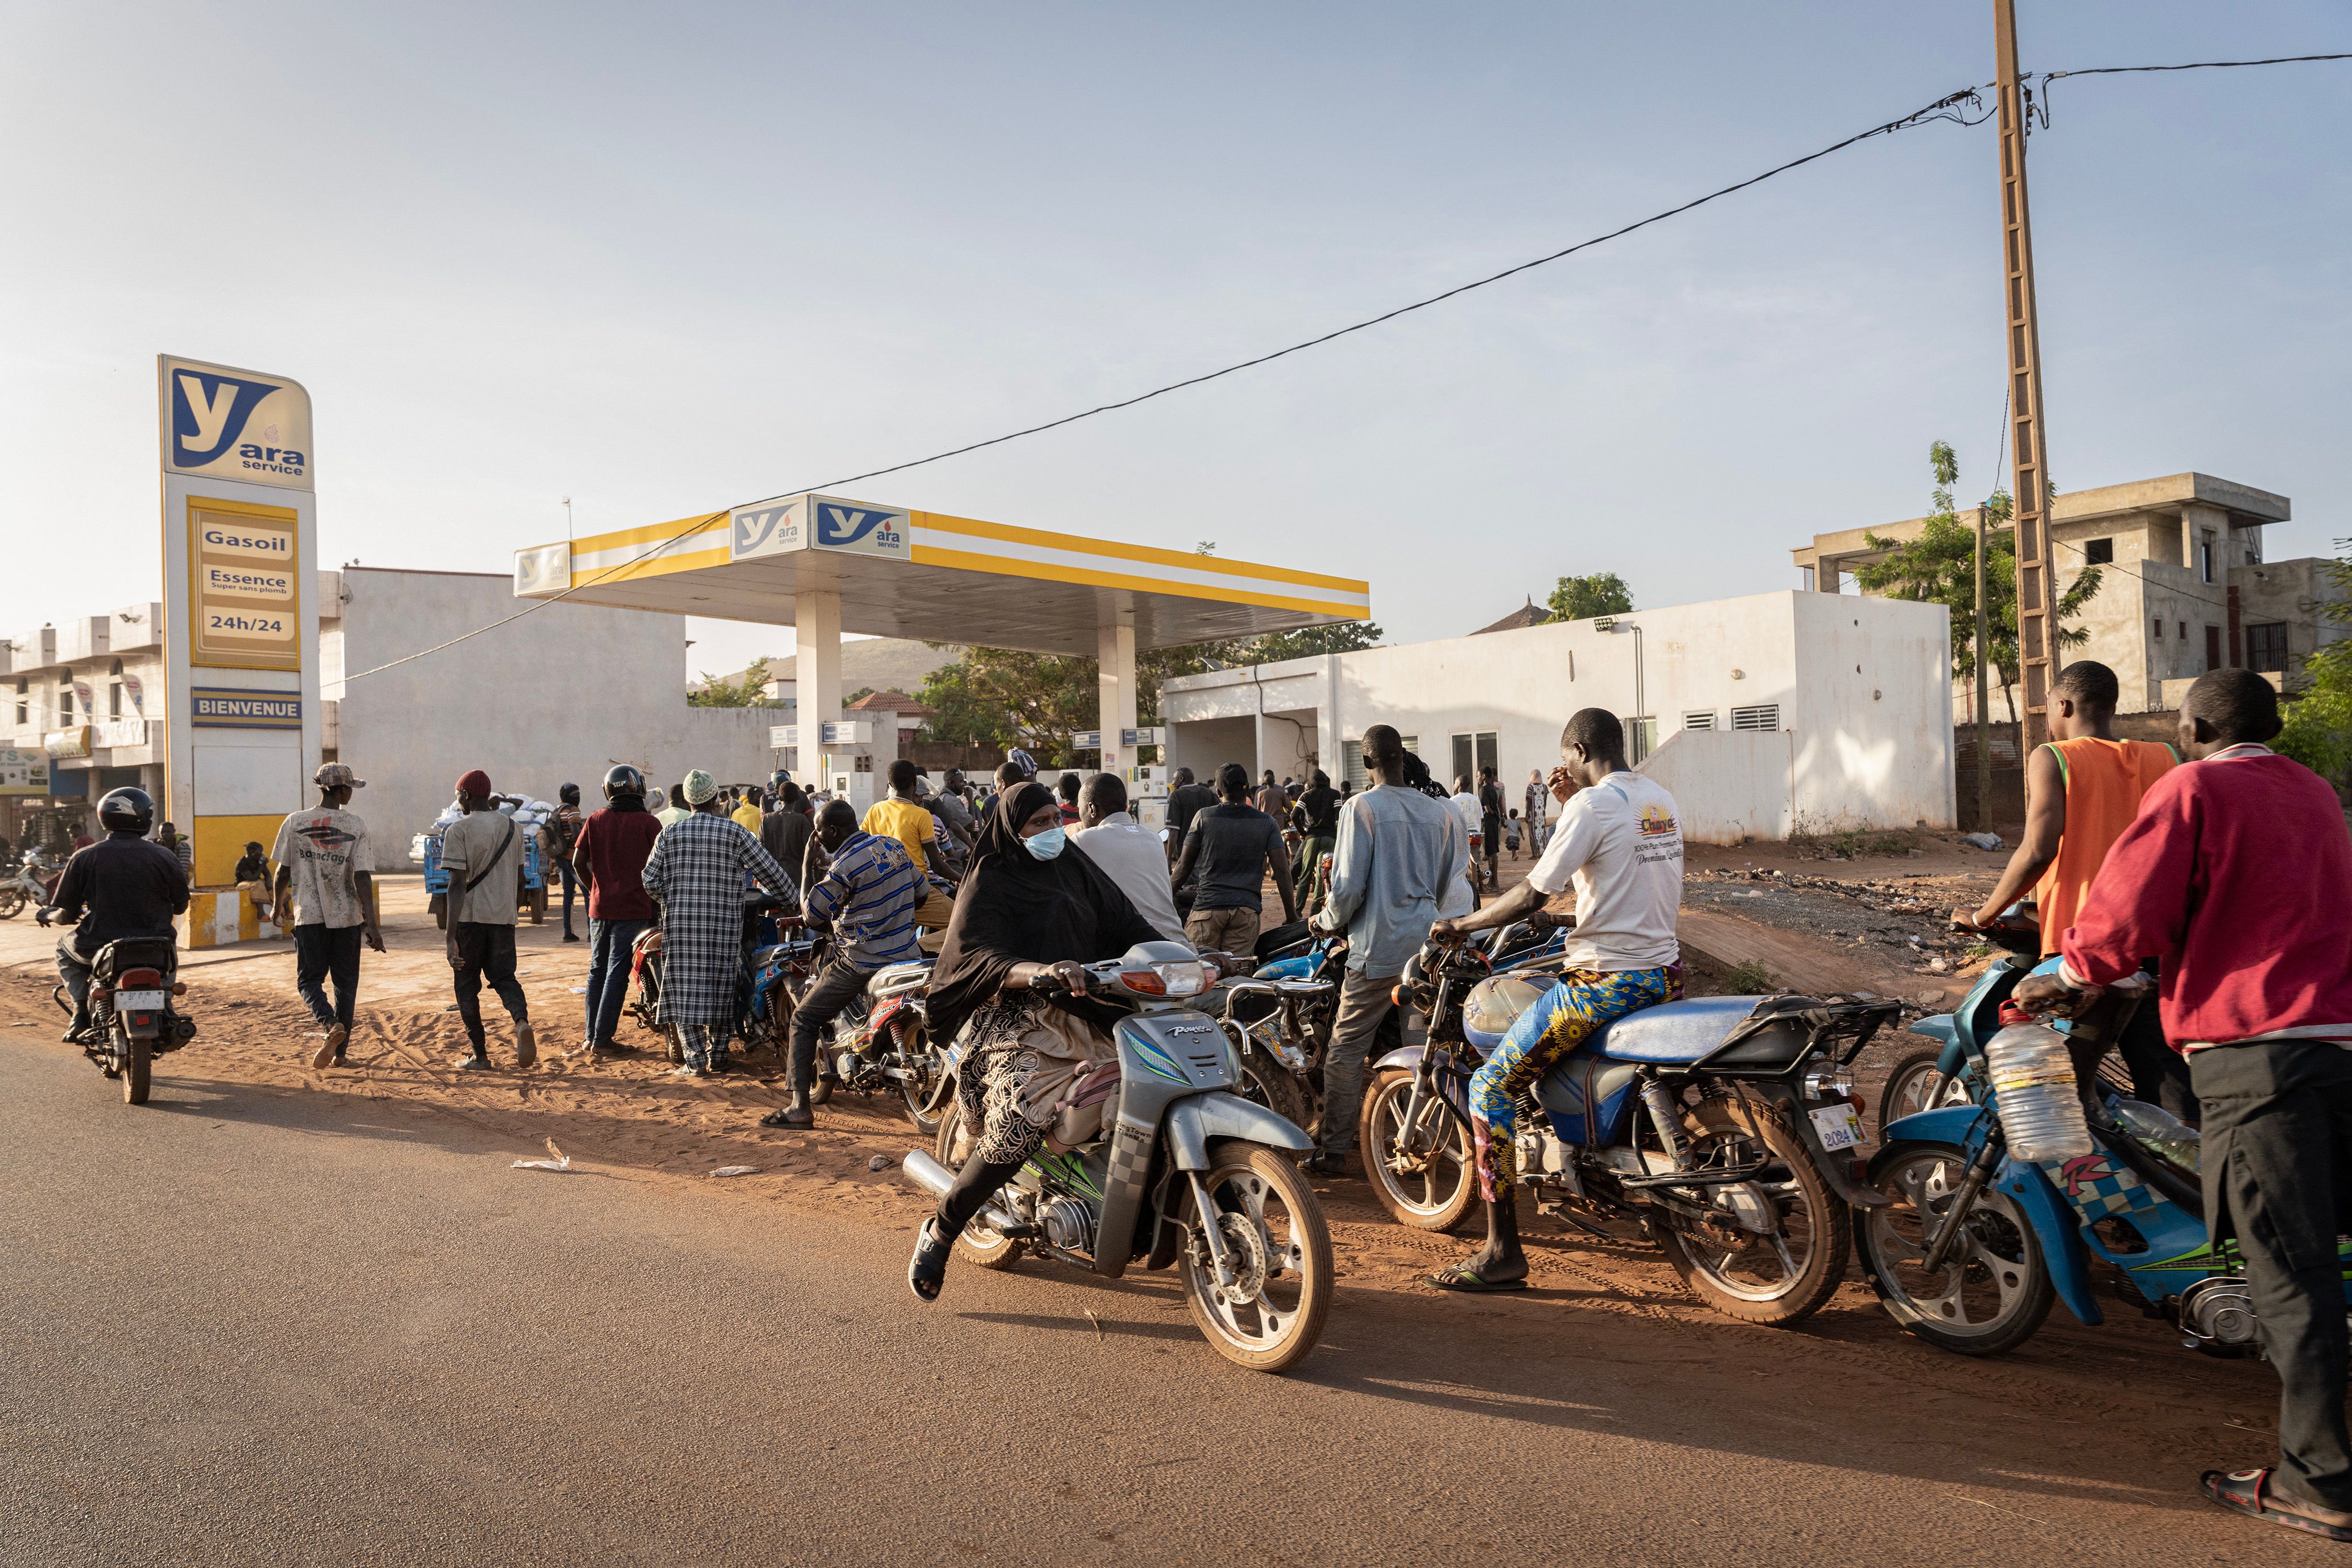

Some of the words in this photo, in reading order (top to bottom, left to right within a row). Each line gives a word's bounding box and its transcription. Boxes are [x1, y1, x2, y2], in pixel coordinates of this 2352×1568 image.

[242, 461, 303, 476] service
[205, 531, 286, 552] Gasoil
[778, 535, 798, 546] service
[877, 541, 900, 550] service
[211, 570, 287, 587] Essence
[212, 583, 237, 591] Super
[259, 587, 287, 595] plomb
[211, 616, 283, 633] 24h/24
[199, 700, 298, 716] BIENVENUE
[1641, 818, 1675, 833] Chaya
